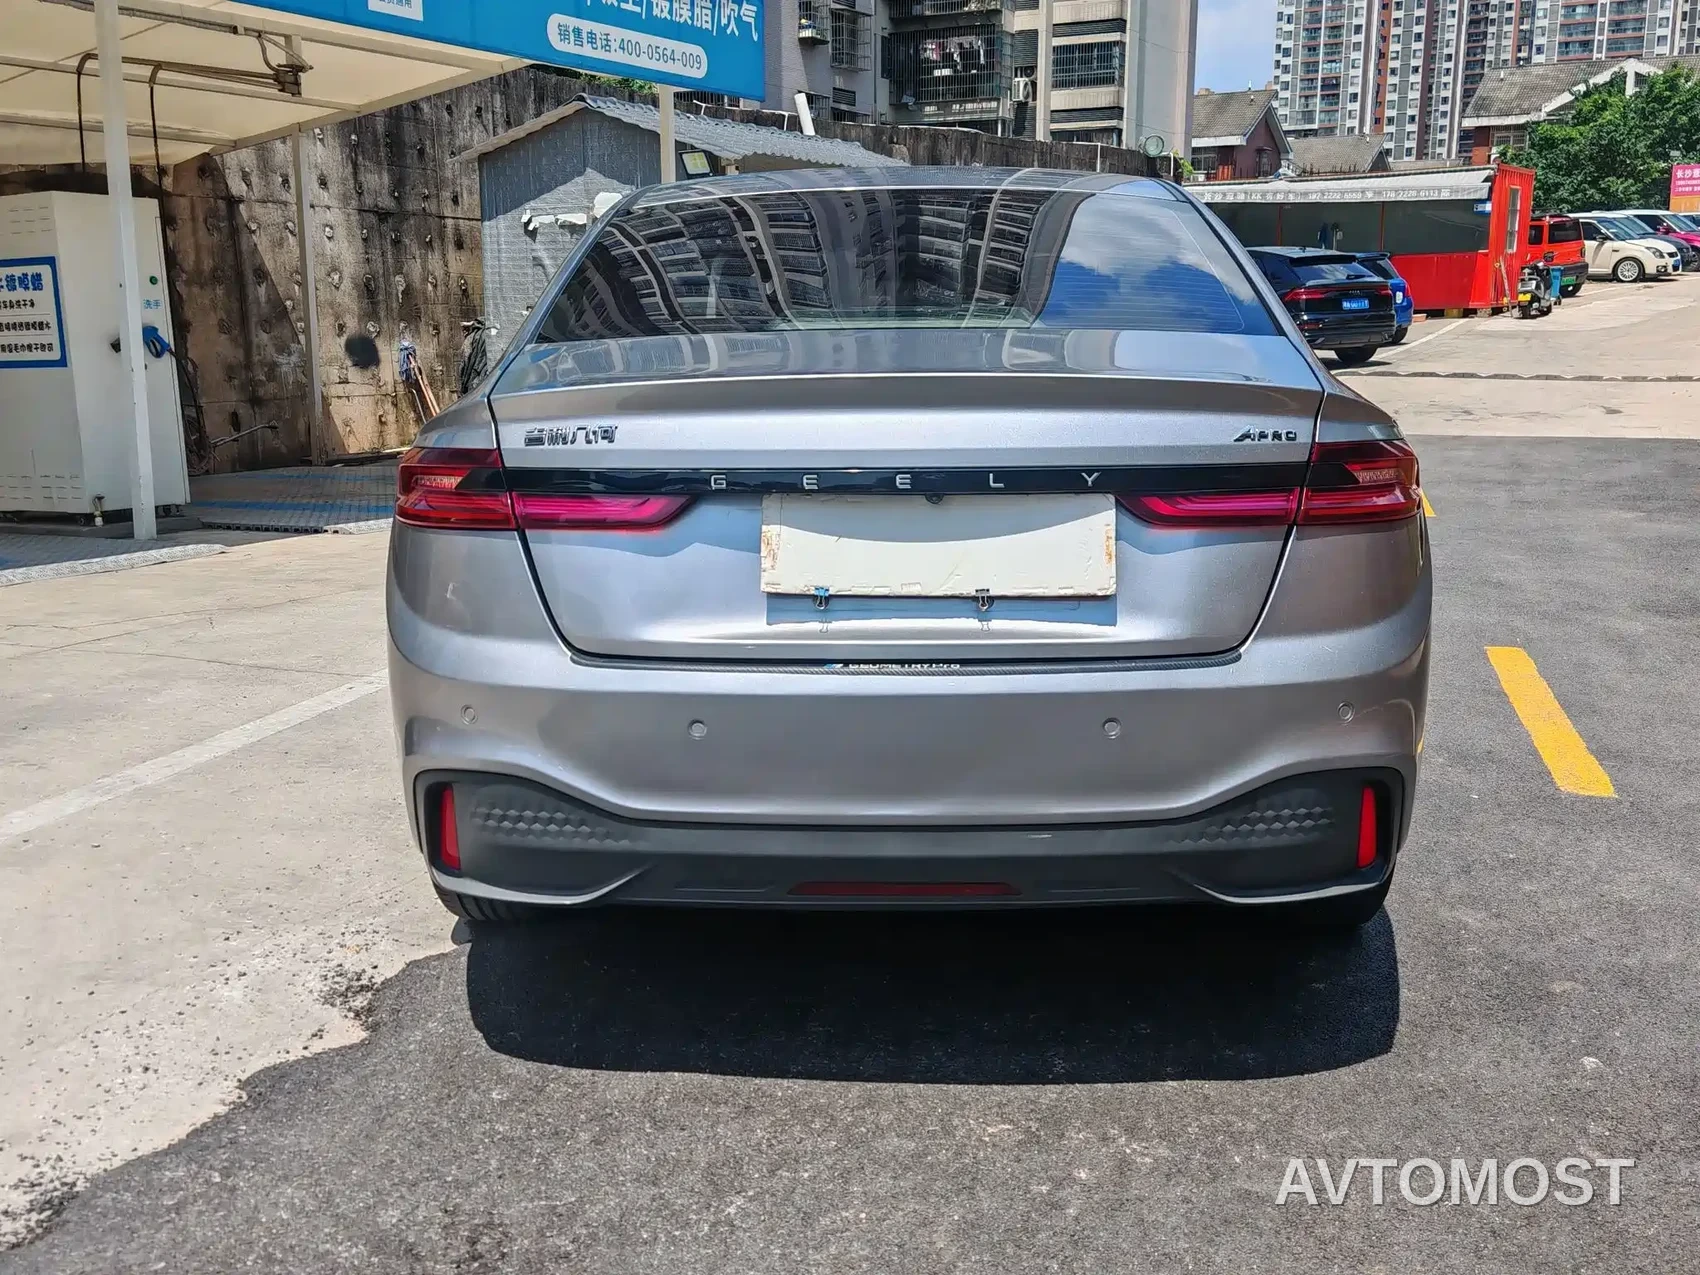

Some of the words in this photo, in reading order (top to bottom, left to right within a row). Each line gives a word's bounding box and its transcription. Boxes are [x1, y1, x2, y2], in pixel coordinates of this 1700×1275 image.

[556, 21, 702, 71] 销售电话:400-0564-009
[143, 298, 162, 310] 洗手
[524, 423, 619, 447] 吉利几何
